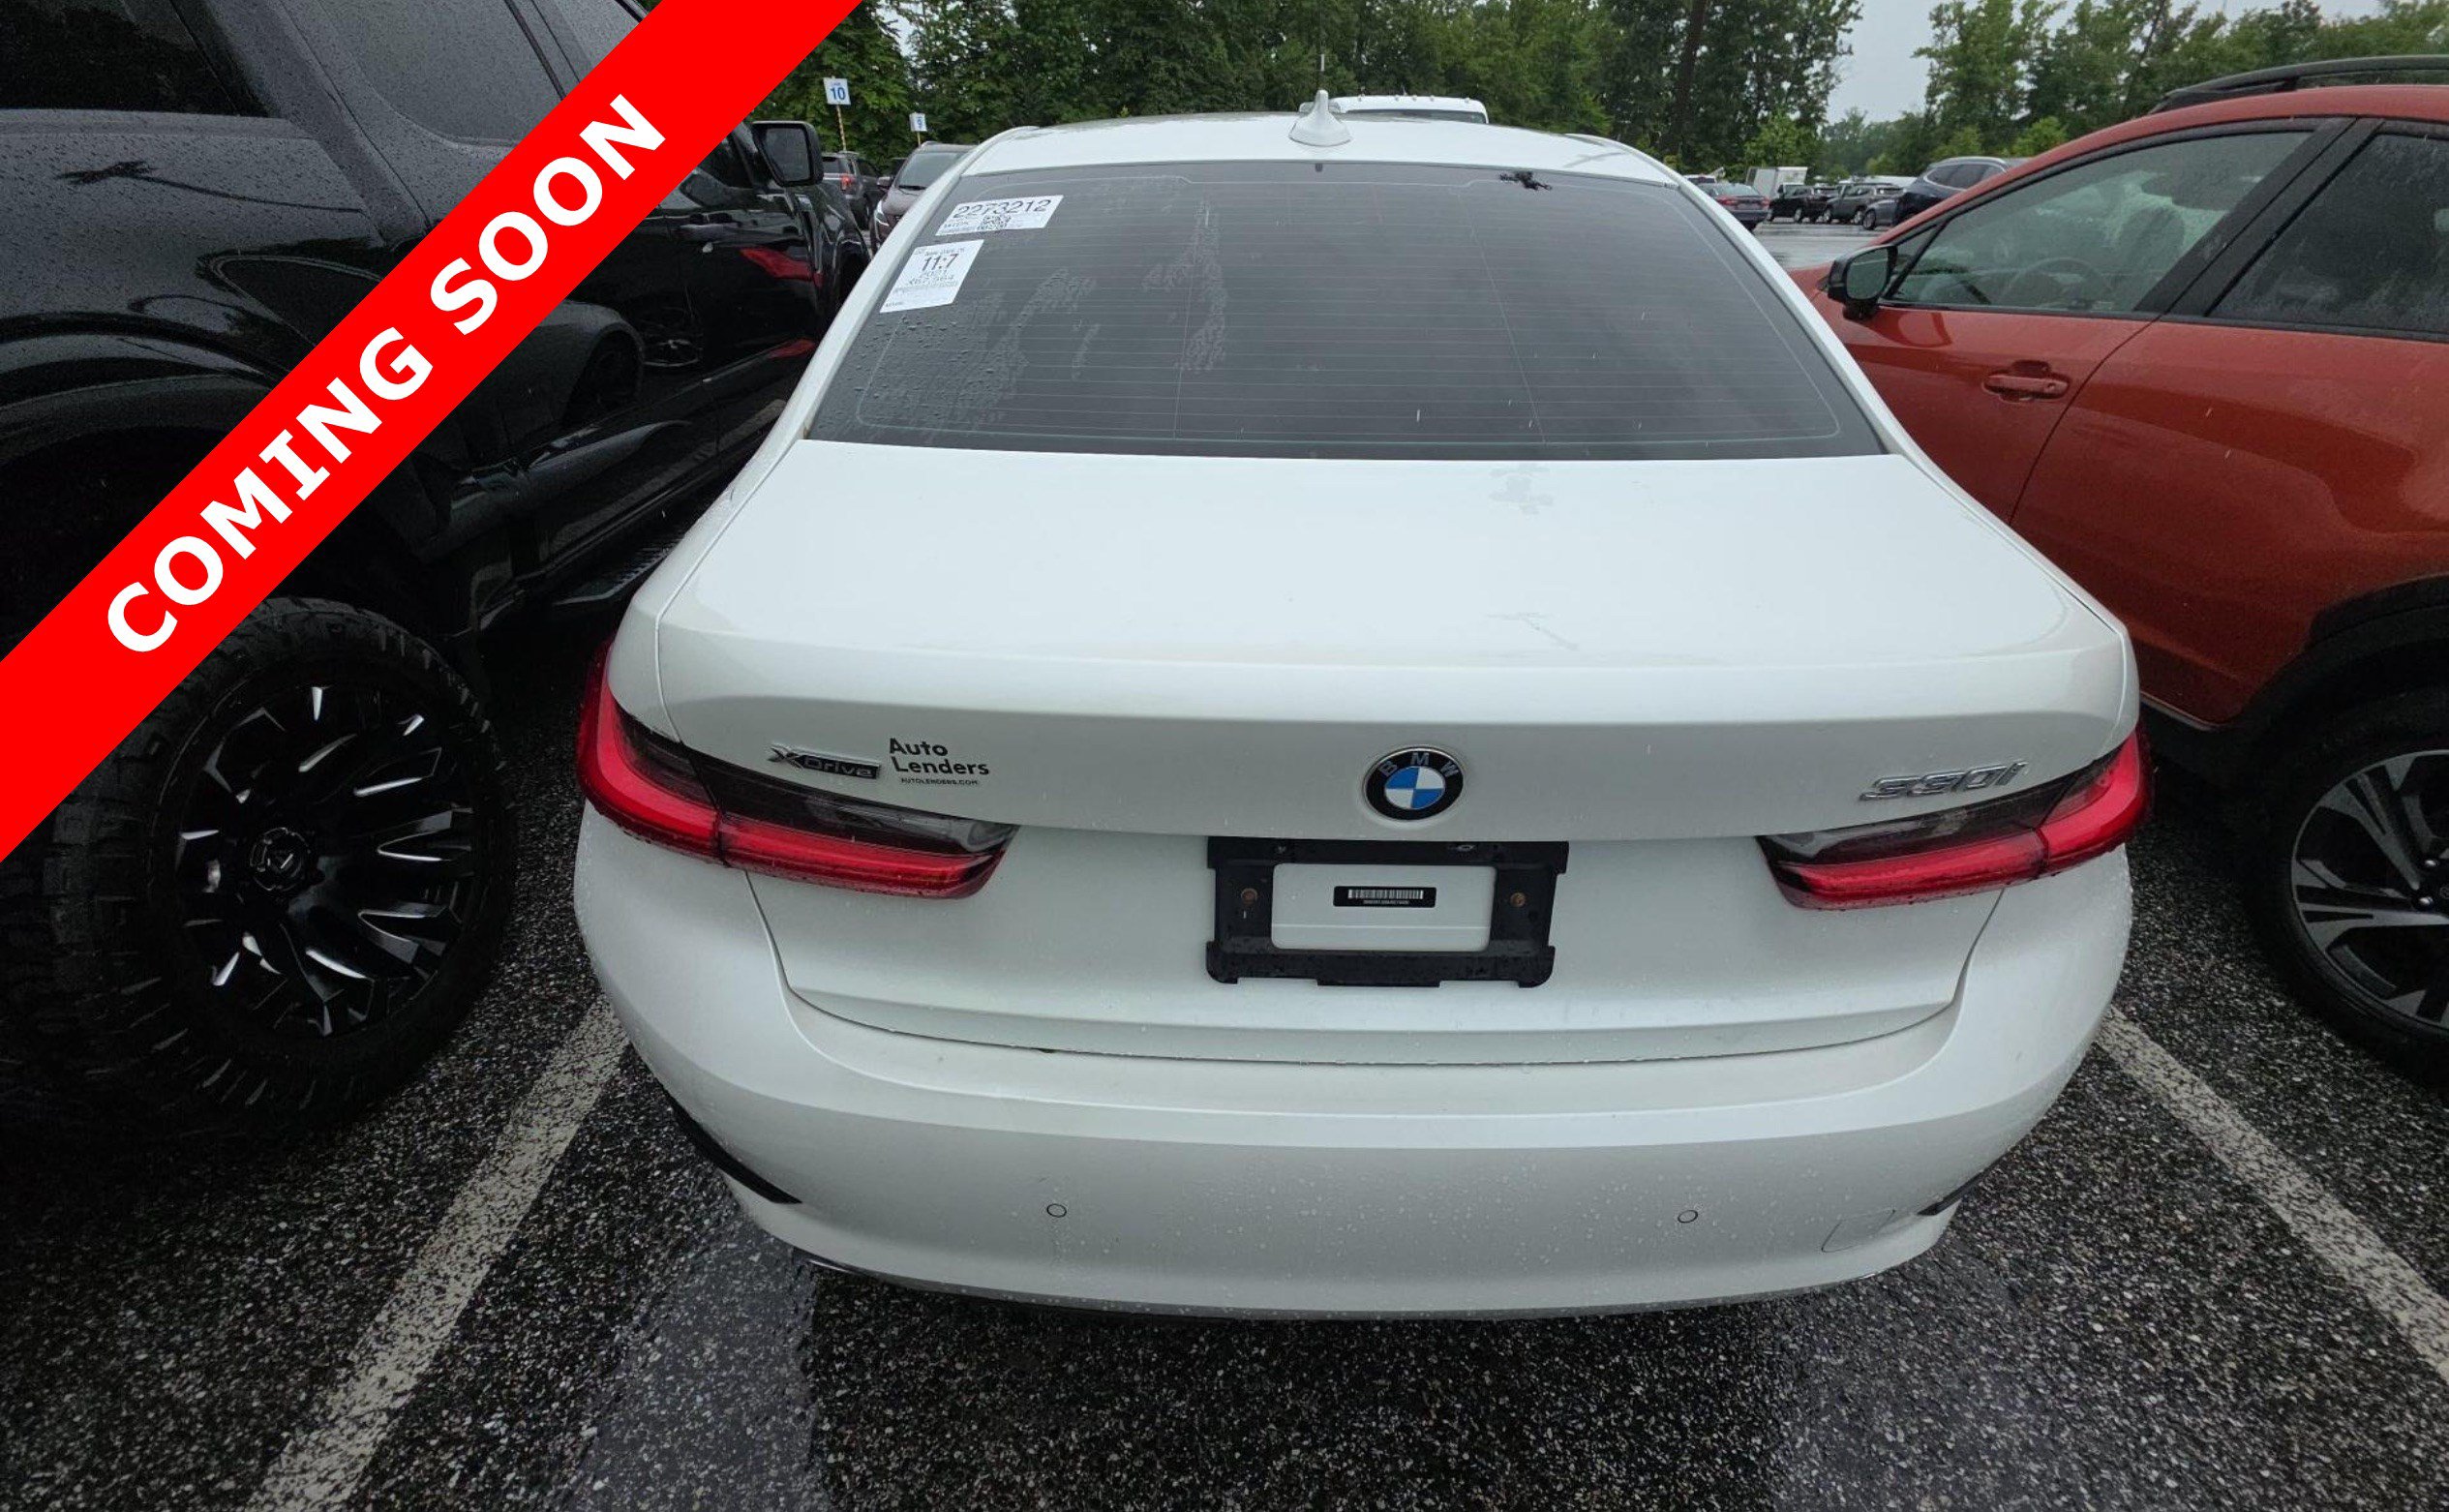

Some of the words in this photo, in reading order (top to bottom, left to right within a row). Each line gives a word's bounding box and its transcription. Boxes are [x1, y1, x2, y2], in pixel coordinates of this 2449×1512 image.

[830, 86, 847, 101] 10
[952, 199, 1051, 219] 2273212
[922, 253, 959, 272] 11:7
[890, 738, 949, 757] Auto
[891, 756, 989, 775] Lenders
[1378, 752, 1460, 777] BMW
[1859, 760, 2029, 801] 330i
